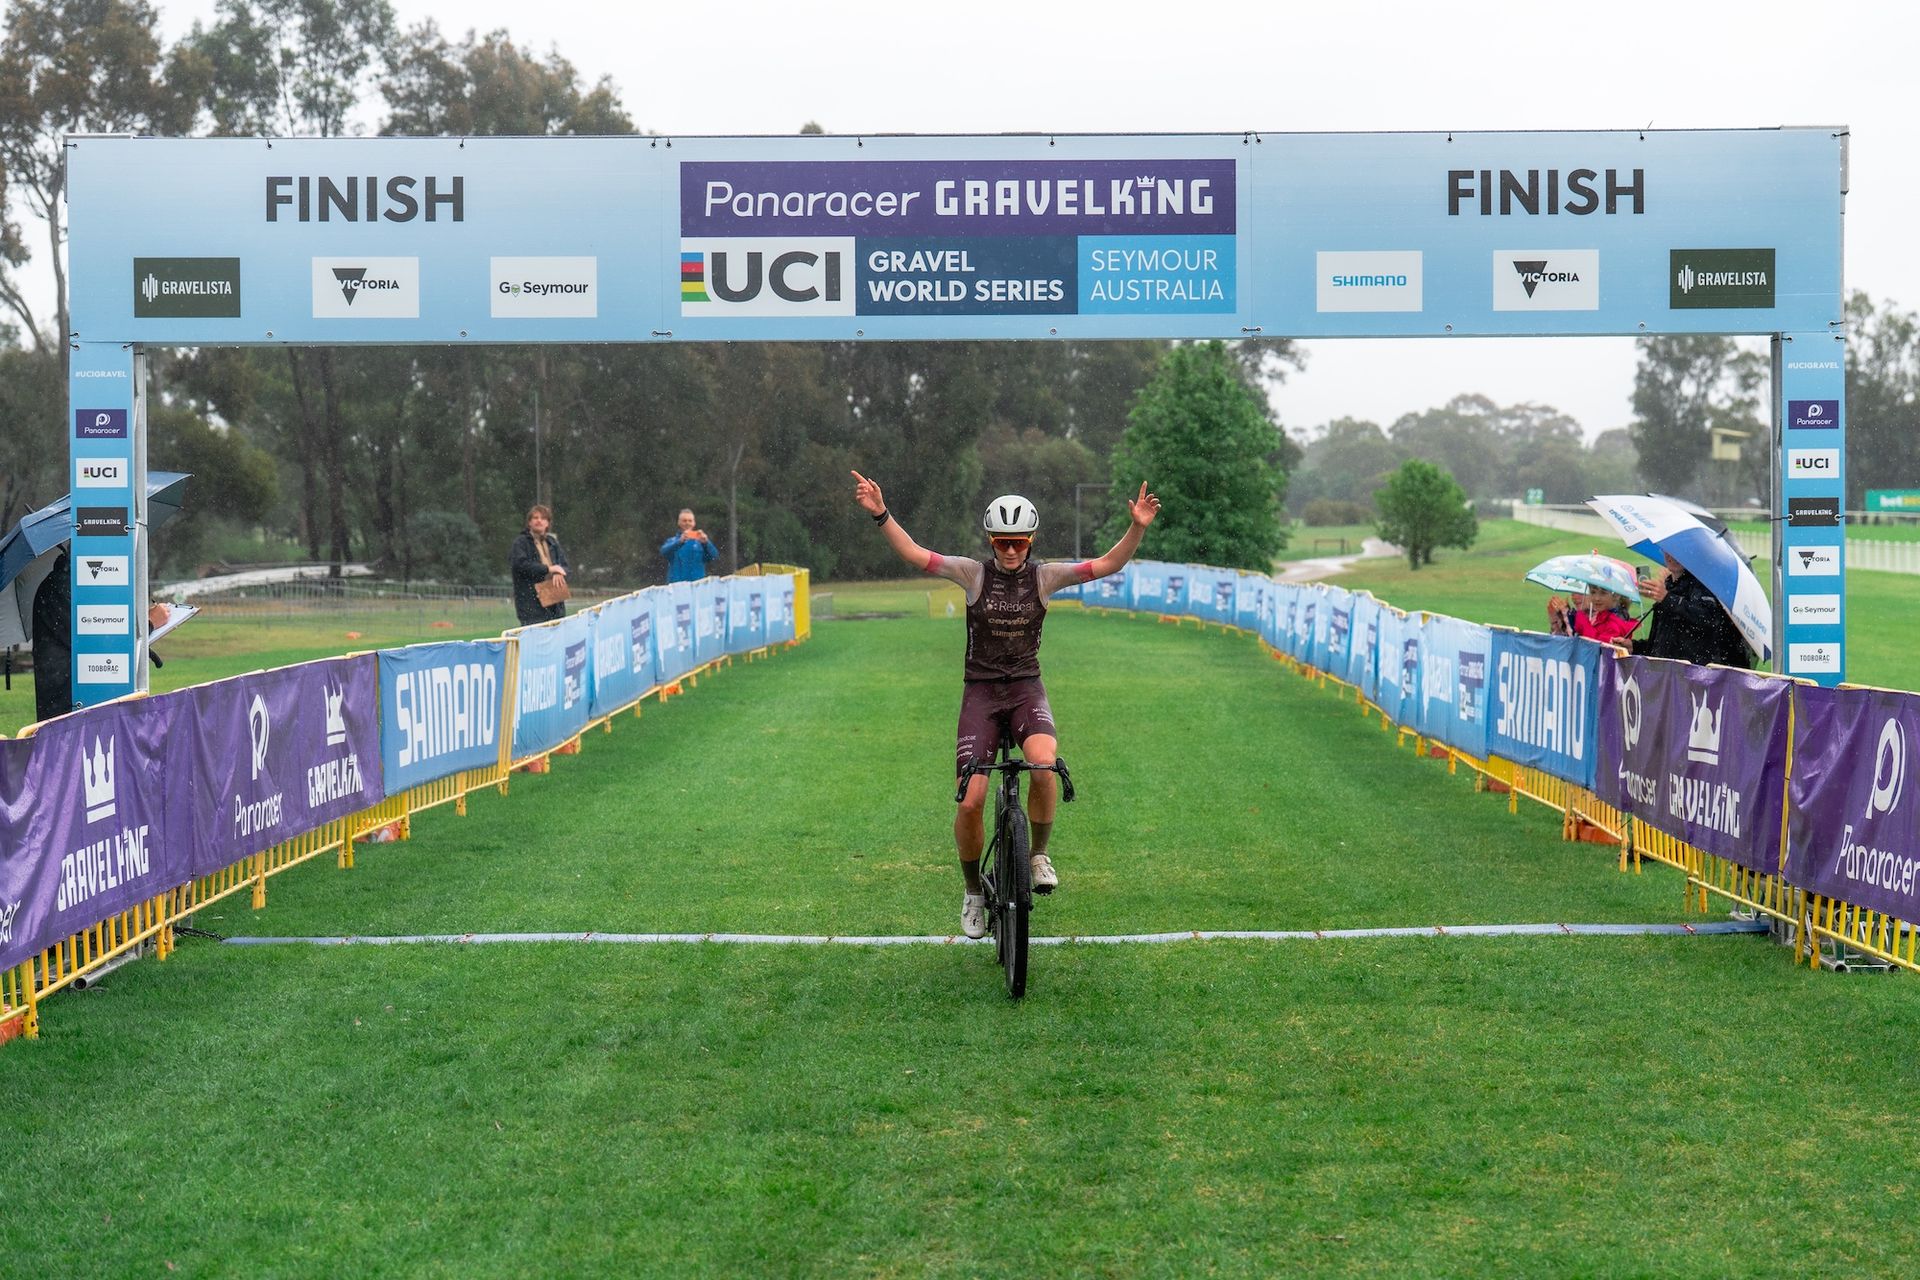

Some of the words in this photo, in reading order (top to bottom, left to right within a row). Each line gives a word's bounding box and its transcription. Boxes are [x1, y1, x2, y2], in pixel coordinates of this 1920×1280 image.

[266, 175, 464, 223] FINISH
[705, 181, 920, 217] Panaracer
[1447, 168, 1645, 216] FINISH
[868, 250, 975, 273] GRAVEL
[1091, 249, 1218, 272] SEYMOUR
[161, 279, 232, 296] GRAVELISTA
[338, 279, 400, 290] VICTORIA
[711, 251, 840, 303] UCI
[1332, 275, 1407, 287] SHIMANO
[1518, 271, 1580, 282] VICTORIA
[1697, 271, 1767, 287] GRAVELISTA
[523, 281, 588, 296] Seymour
[868, 280, 967, 303] WORLD
[974, 279, 1064, 302] SERIES
[1090, 279, 1224, 302] AUSTRALIA
[75, 370, 127, 378] #UCIGRAVEL
[90, 467, 117, 478] UCI
[1802, 458, 1829, 469] UCI
[92, 616, 125, 624] Seymour
[1804, 606, 1836, 614] Seymour
[396, 663, 496, 768] SHIMANO
[1497, 651, 1586, 761] SHIMANO
[234, 792, 283, 840] Panaracer
[1834, 824, 1920, 897] Panaracer
